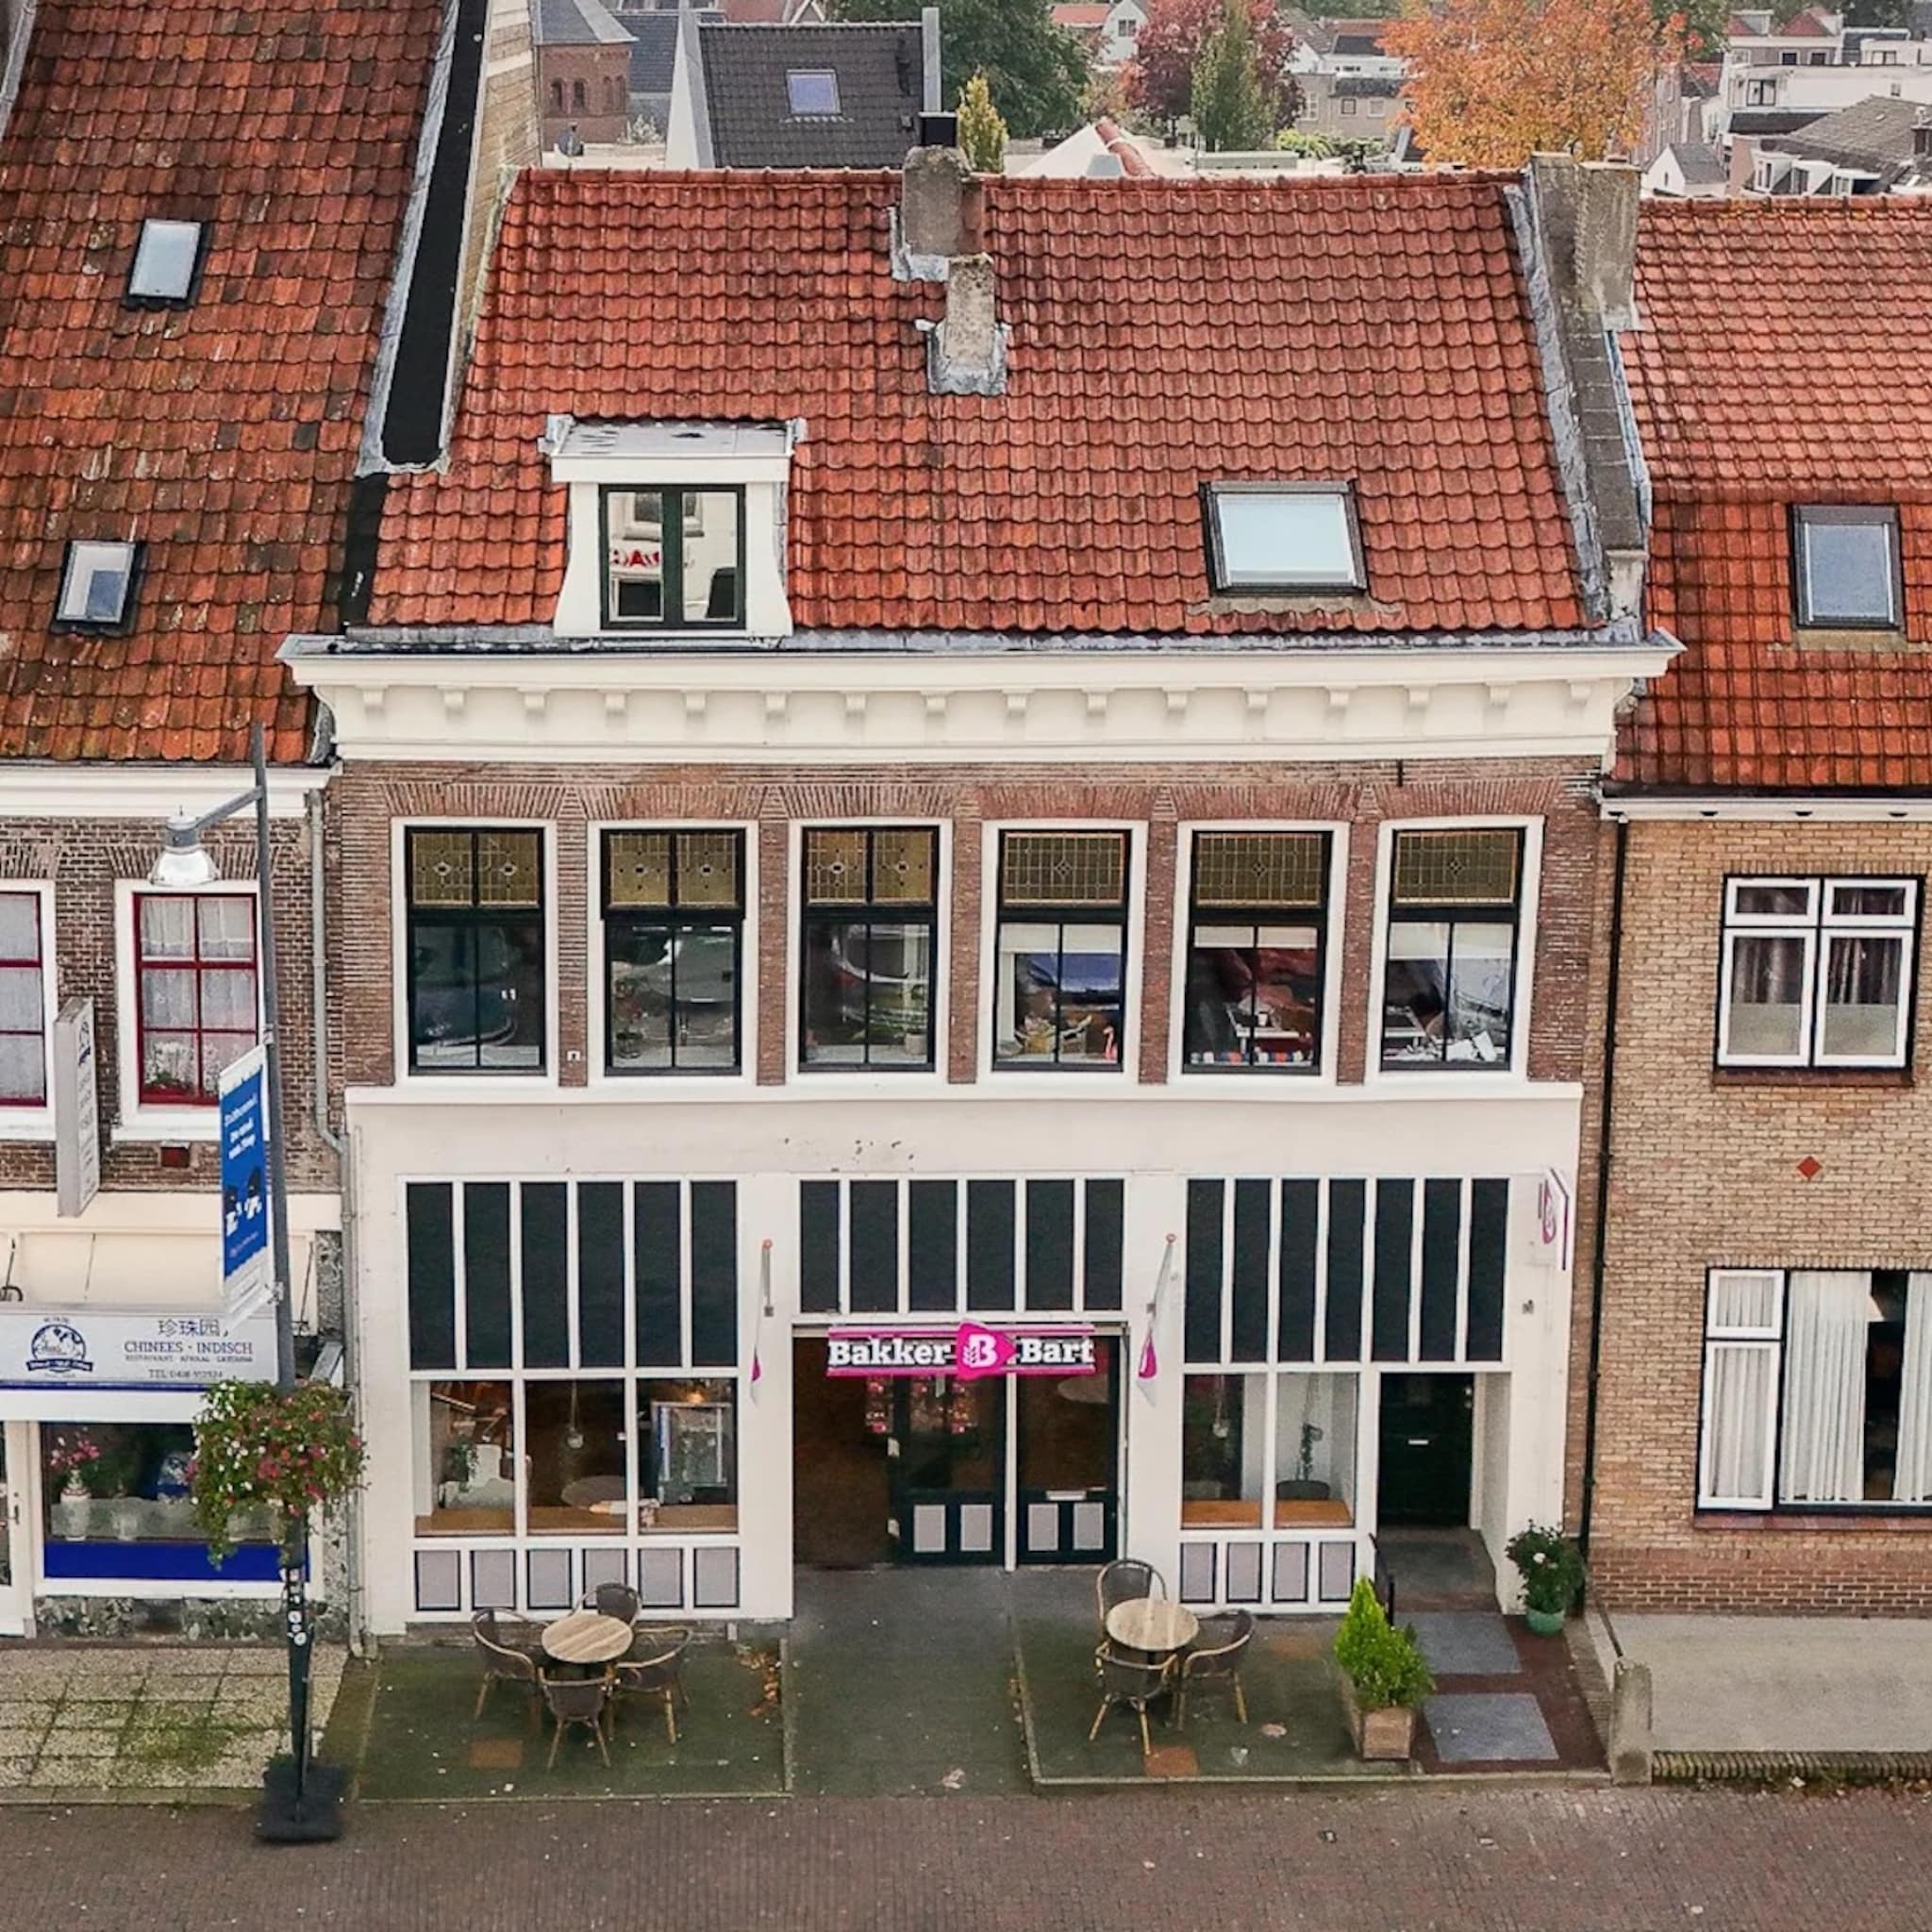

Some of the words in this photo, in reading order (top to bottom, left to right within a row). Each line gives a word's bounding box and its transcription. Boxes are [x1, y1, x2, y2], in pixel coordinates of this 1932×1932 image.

[124, 1341, 184, 1354] CHINEES
[196, 1341, 253, 1355] INDISCH
[827, 1335, 954, 1366] Bakker
[962, 1333, 997, 1368] B
[1018, 1335, 1095, 1364] Bart
